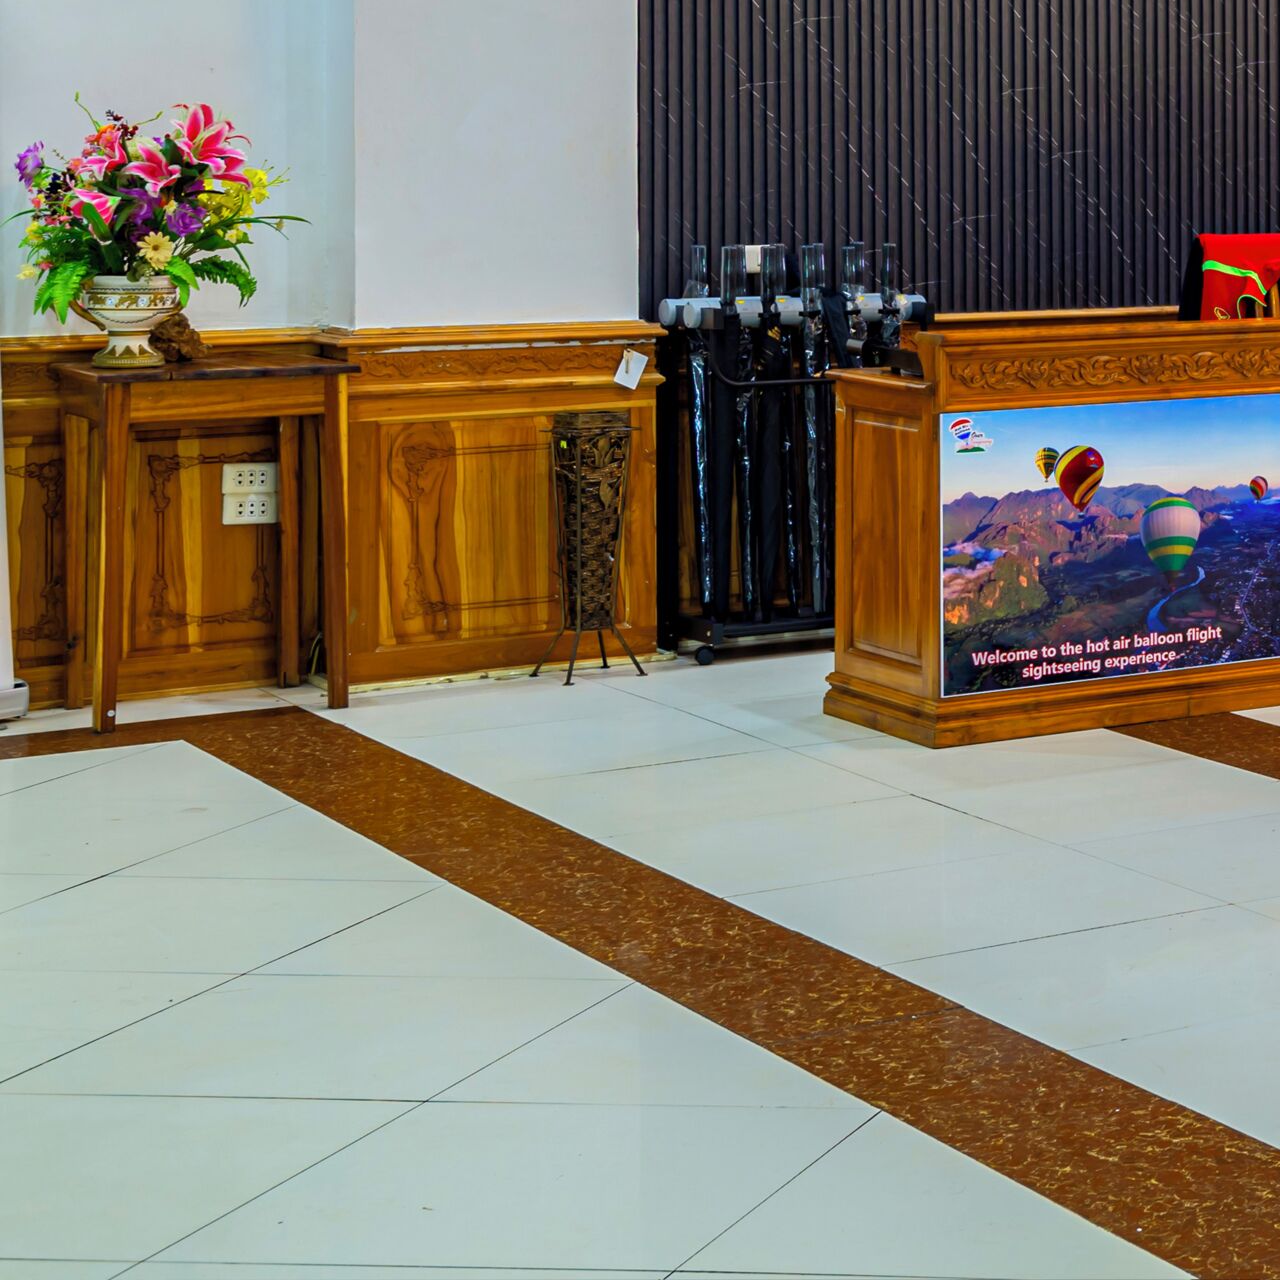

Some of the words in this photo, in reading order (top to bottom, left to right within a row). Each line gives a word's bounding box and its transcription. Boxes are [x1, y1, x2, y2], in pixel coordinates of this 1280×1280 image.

[972, 648, 1038, 666] Welcome
[1042, 646, 1056, 658] to
[1060, 642, 1083, 657] the
[1086, 638, 1110, 654] hot
[1112, 636, 1131, 650] air
[1134, 630, 1183, 648] balloon
[1186, 626, 1222, 644] flight
[1022, 659, 1100, 680] sightseeing
[1104, 650, 1176, 669] experience
